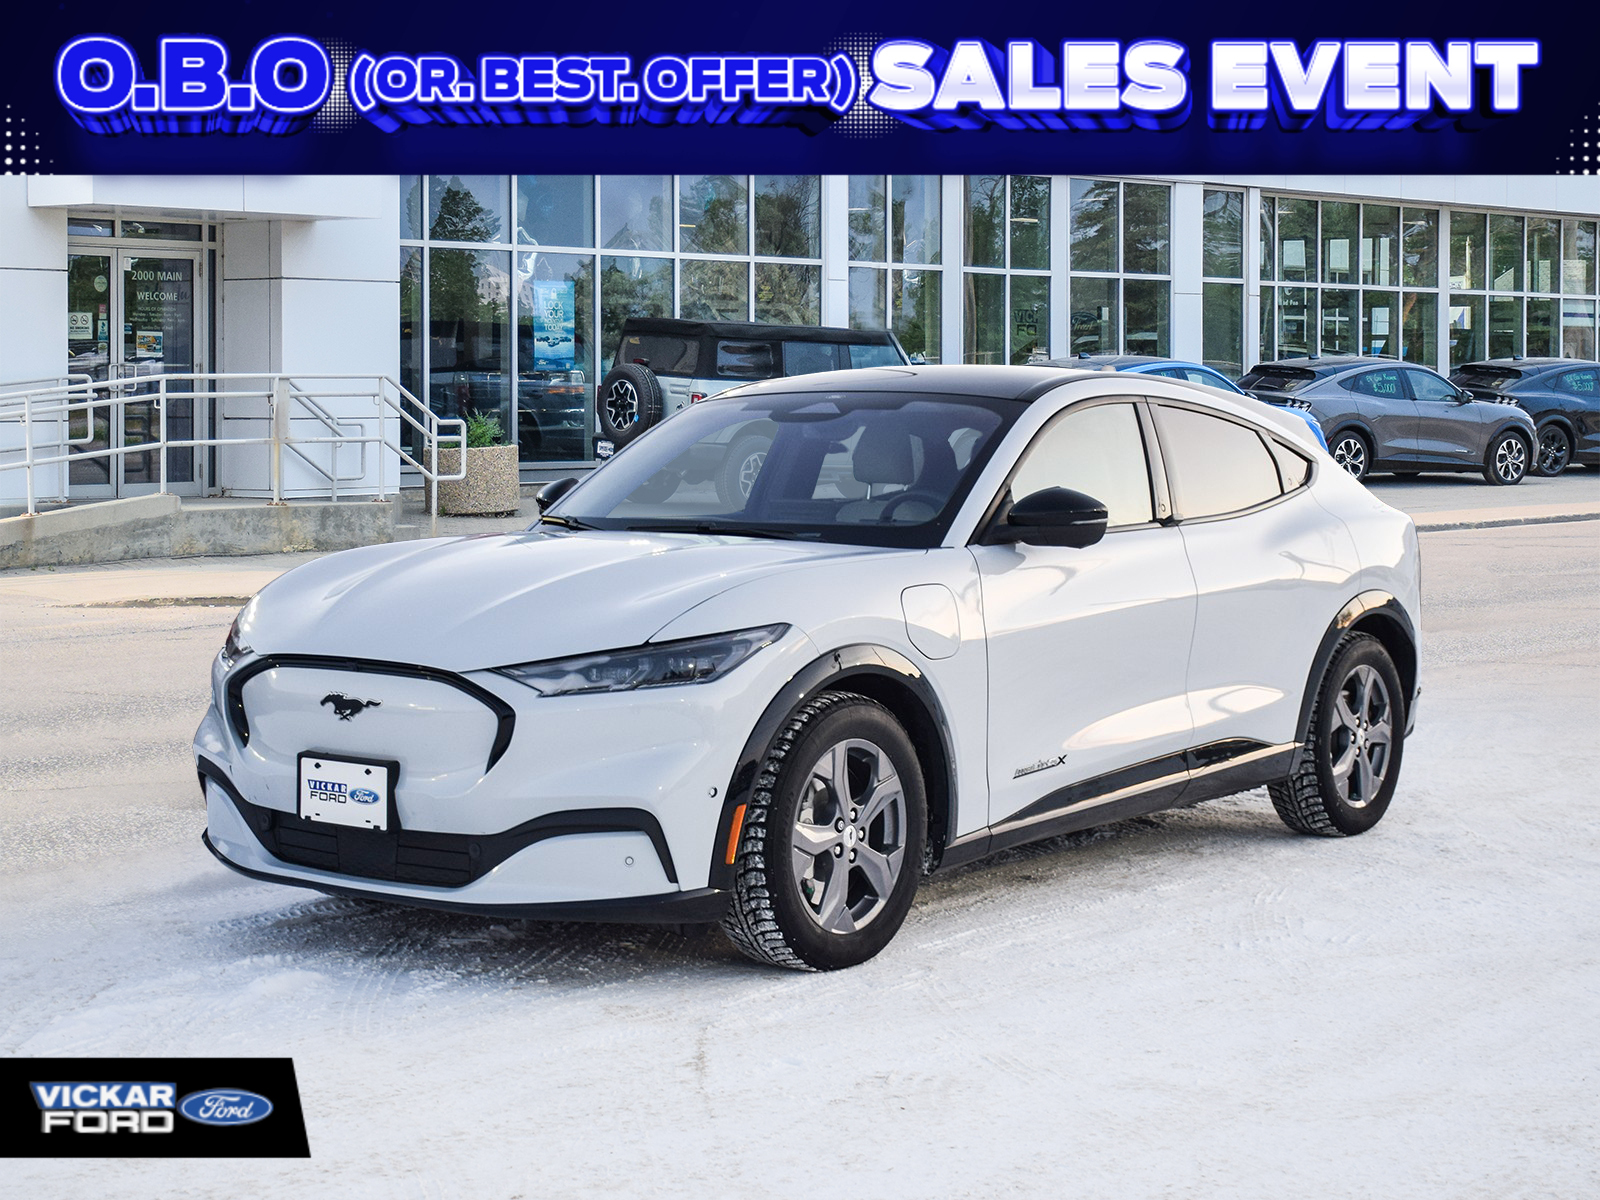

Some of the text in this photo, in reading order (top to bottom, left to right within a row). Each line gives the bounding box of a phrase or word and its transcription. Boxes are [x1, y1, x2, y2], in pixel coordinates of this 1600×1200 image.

[131, 270, 183, 281] 2000 MAIN
[136, 291, 178, 301] WELCOME
[543, 301, 564, 310] LOCK
[544, 310, 564, 318] YOUR
[308, 780, 374, 803] VICKAR Ford
[310, 791, 347, 804] FORD
